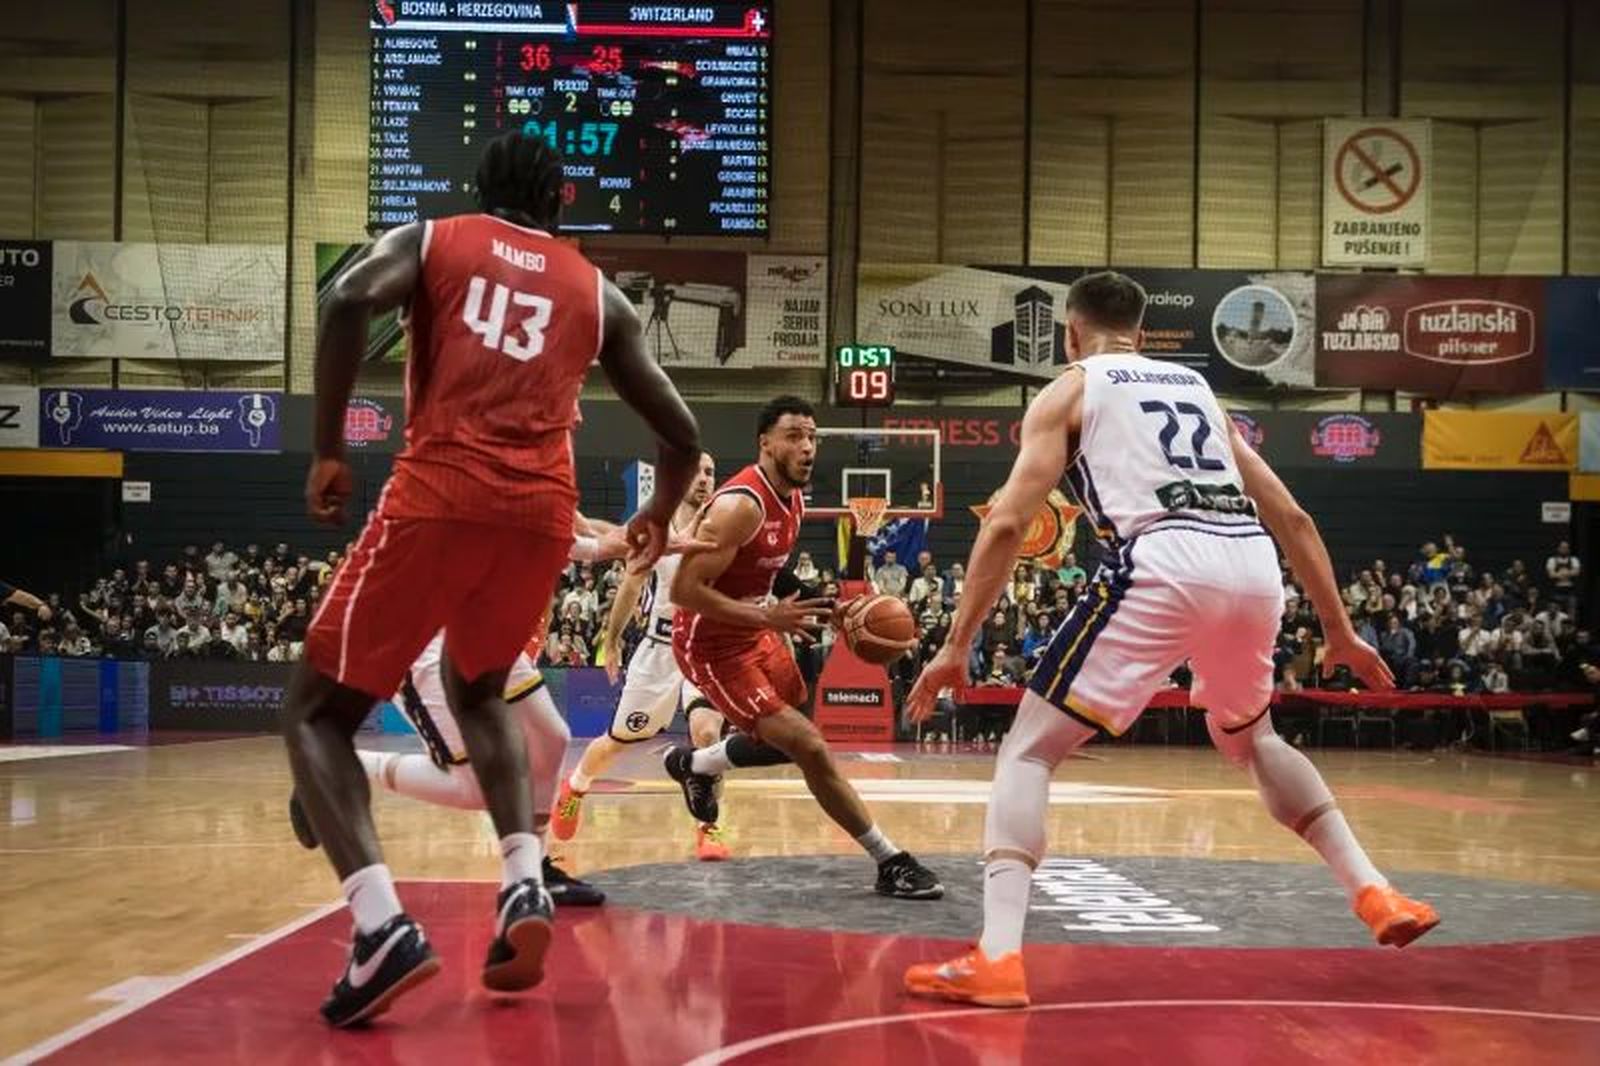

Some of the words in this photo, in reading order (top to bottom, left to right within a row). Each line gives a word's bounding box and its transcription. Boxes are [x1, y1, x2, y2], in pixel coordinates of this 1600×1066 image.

[401, 2, 447, 16] BOSNIA
[457, 4, 543, 18] HERZEGOVINA
[630, 7, 714, 22] SWITZERLAND
[519, 44, 551, 71] 36
[592, 46, 624, 73] 25
[565, 92, 577, 112] 2
[599, 177, 632, 189] BONUS
[609, 194, 621, 214] 4
[1333, 221, 1421, 236] ZABRANJENO
[492, 238, 546, 273] MAMBO
[1344, 240, 1401, 255] PUŠENJE
[941, 300, 981, 318] LUX
[463, 276, 554, 362] 43
[783, 316, 820, 330] SERVIS
[1420, 305, 1517, 333] tuzlanski
[772, 331, 819, 347] PRODAJA
[1322, 332, 1400, 351] TUZLANSKO
[1439, 337, 1498, 356] pilsner
[850, 371, 888, 399] 09
[91, 406, 137, 418] Audio
[140, 407, 182, 419] Video
[187, 407, 234, 423] Light
[103, 423, 219, 437] www.setup.ba
[880, 418, 1001, 447] FITNESS
[1139, 400, 1226, 470] 22
[827, 691, 880, 703] telemach
